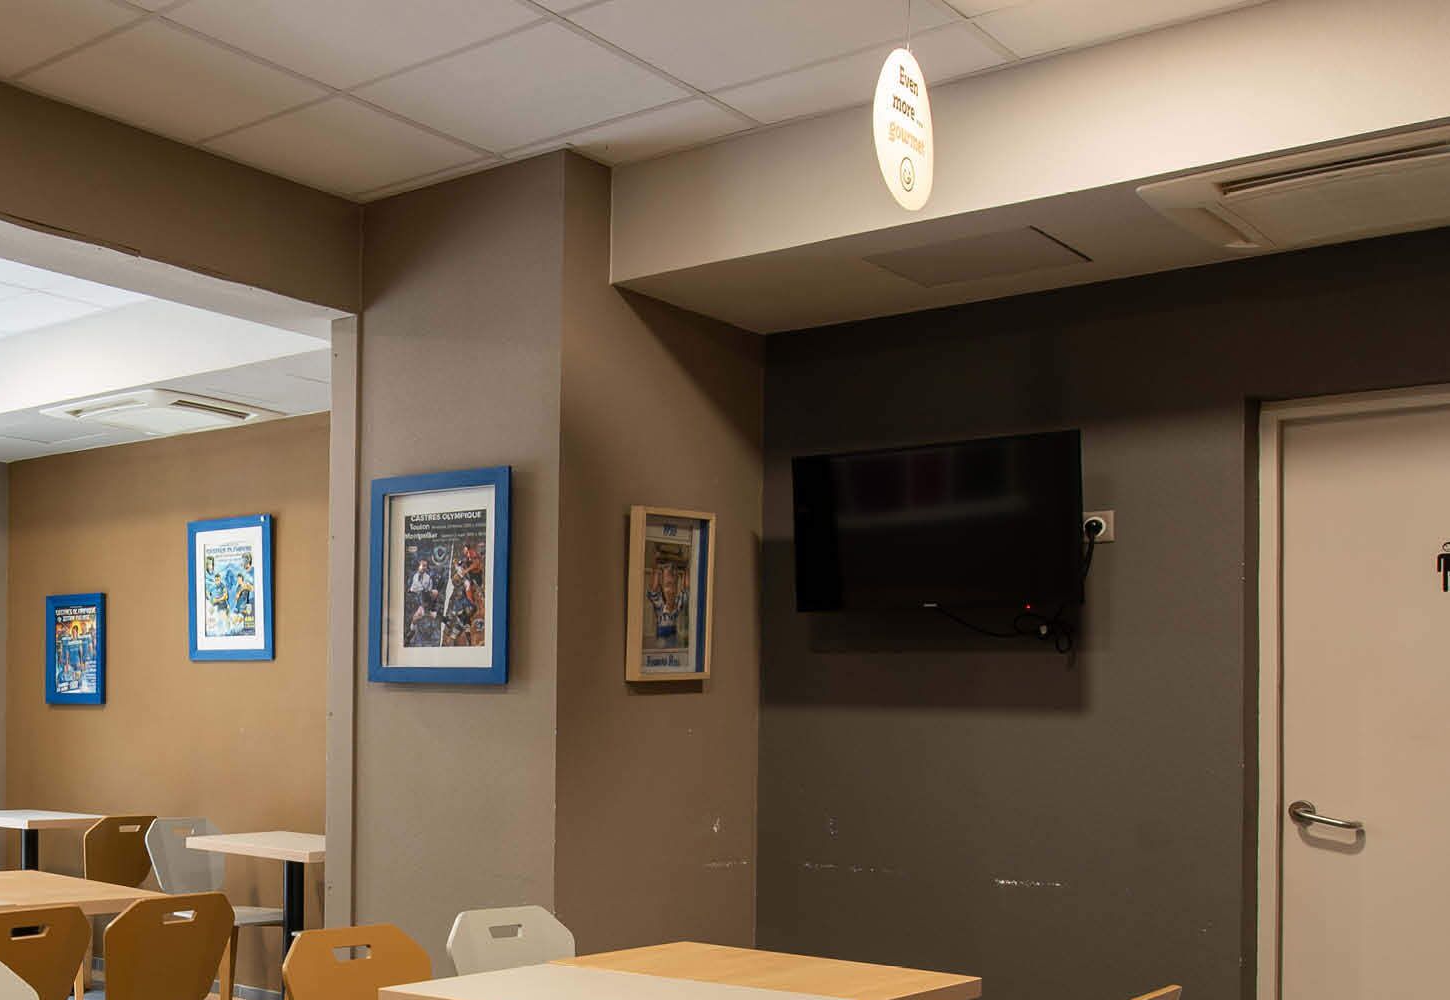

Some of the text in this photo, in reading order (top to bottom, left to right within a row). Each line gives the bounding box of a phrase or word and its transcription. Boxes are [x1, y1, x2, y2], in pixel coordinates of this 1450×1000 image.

[899, 65, 919, 97] Even
[411, 511, 481, 522] CASTRES OLYMPIQUE
